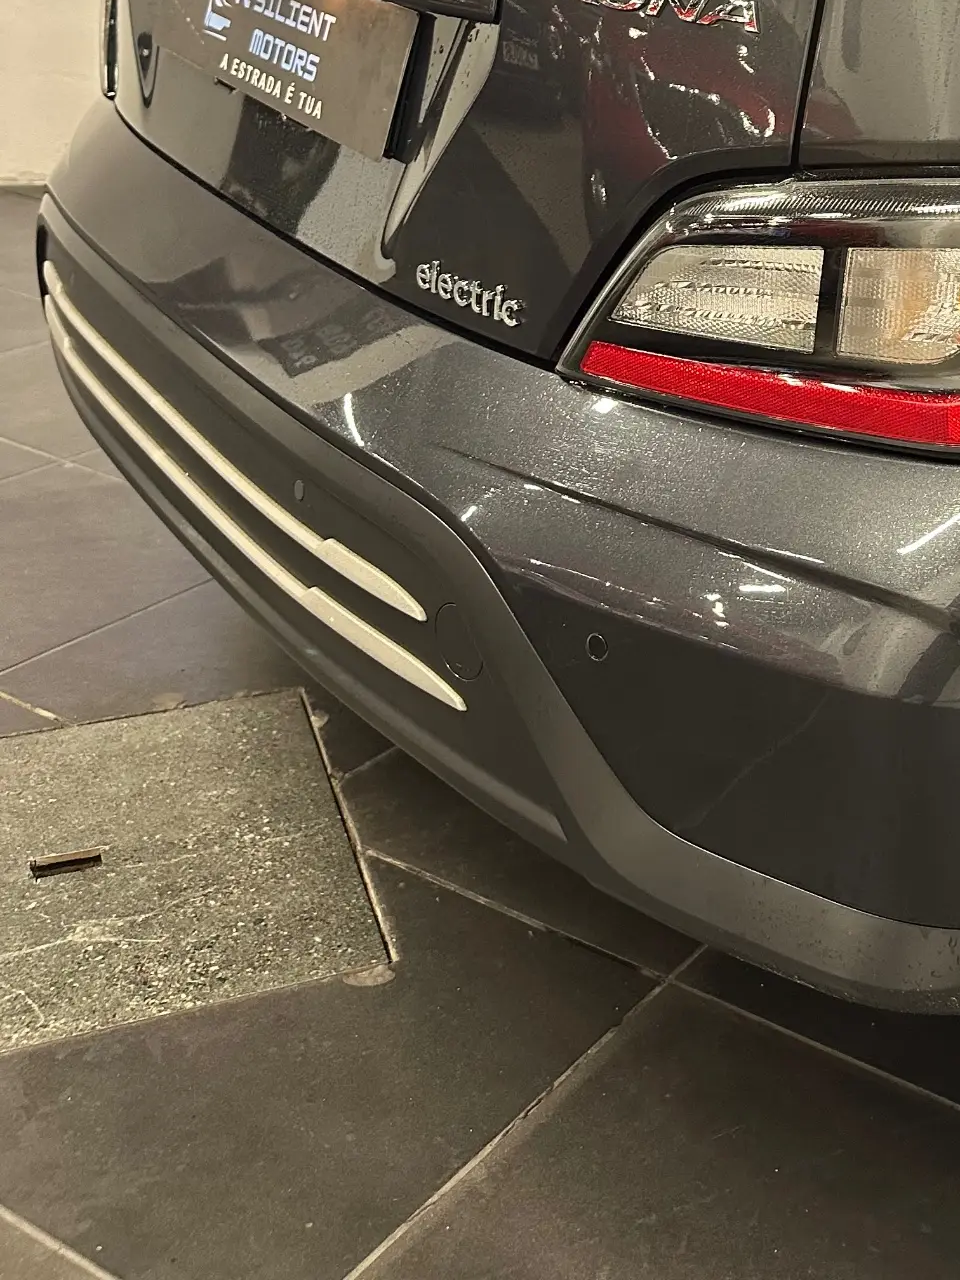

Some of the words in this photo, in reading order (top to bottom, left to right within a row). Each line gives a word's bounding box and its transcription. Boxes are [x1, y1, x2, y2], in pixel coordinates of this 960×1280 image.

[218, 52, 230, 72] A
[229, 56, 282, 100] ESTRADA
[284, 81, 297, 106] É
[297, 91, 323, 120] TUA
[247, 28, 322, 84] MOTORS
[415, 259, 524, 328] electric
